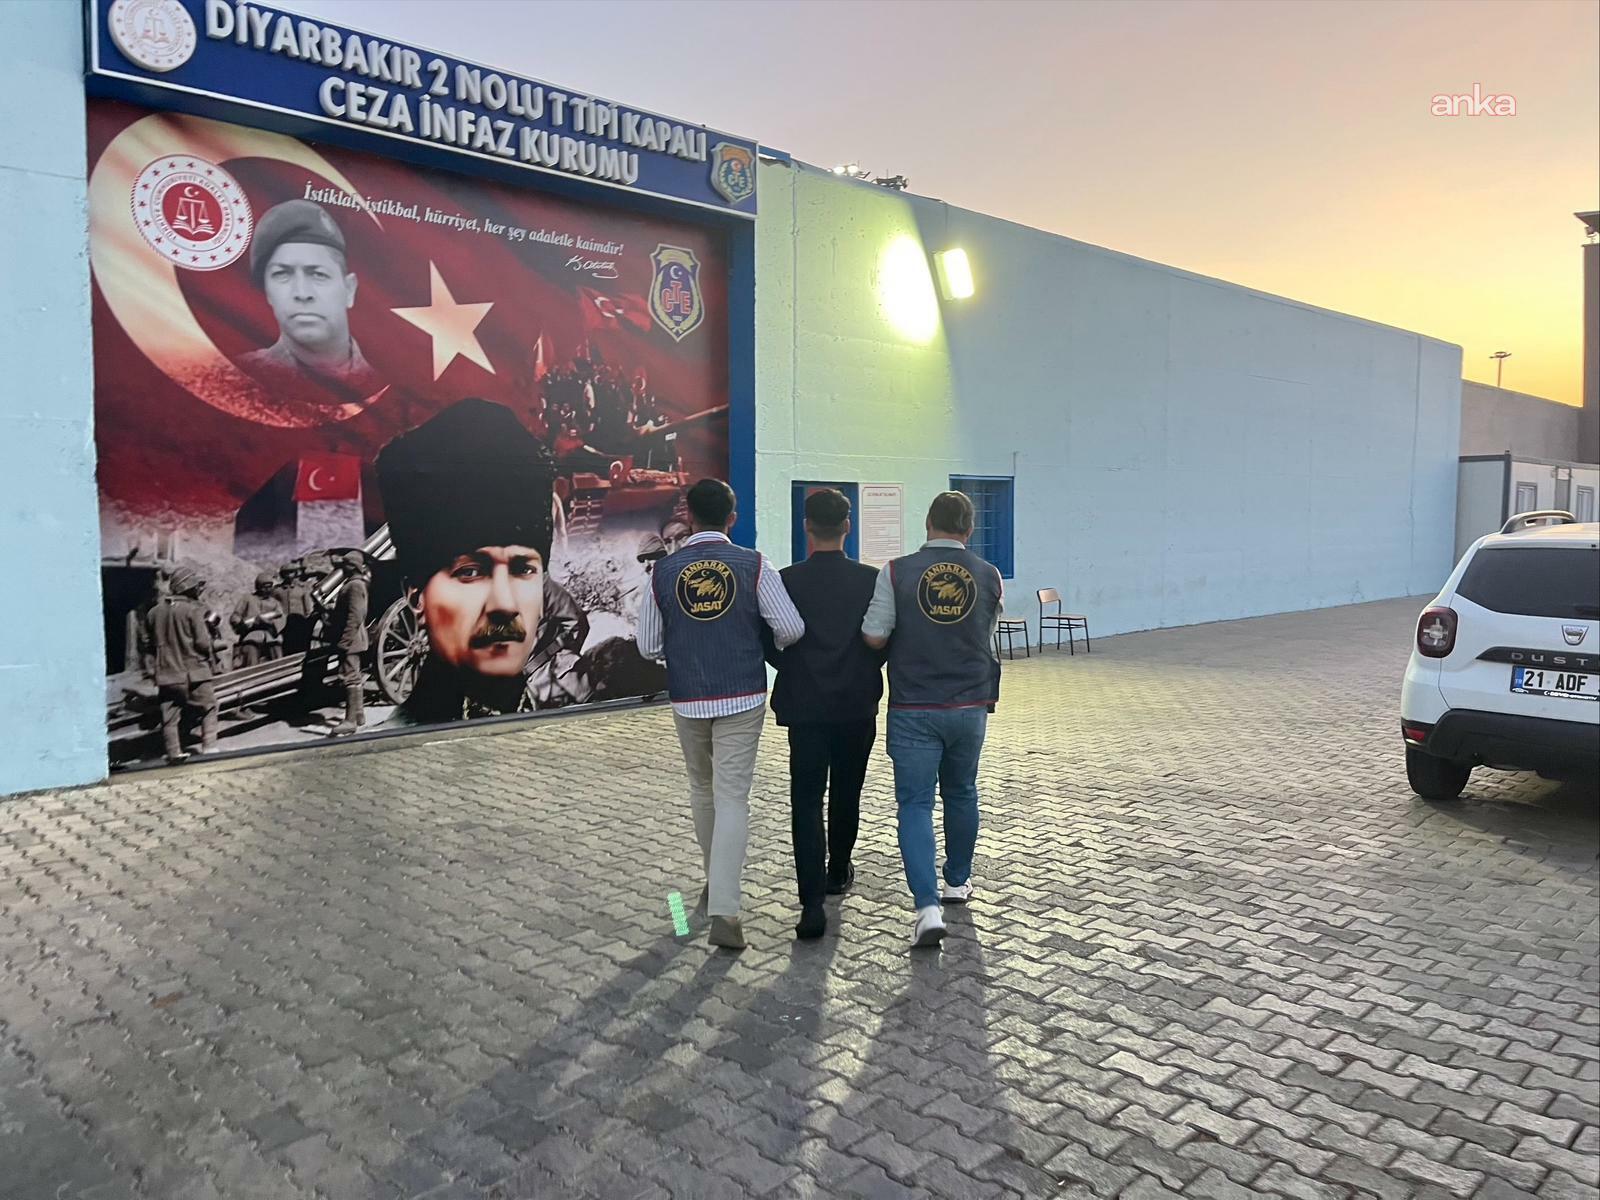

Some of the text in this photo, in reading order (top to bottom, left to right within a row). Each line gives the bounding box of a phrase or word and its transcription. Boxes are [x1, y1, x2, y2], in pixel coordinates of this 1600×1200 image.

[206, 0, 423, 88] DİYARBAKIR
[427, 58, 450, 97] 2
[455, 65, 544, 120] NOLU
[548, 91, 567, 127] T
[569, 96, 619, 140] TİPİ
[622, 111, 707, 162] KAPALI
[318, 76, 639, 185] CEZA İNFAZ KURUMU
[484, 218, 506, 235] her
[508, 226, 528, 242] şey
[529, 228, 574, 248] adaletle
[681, 561, 731, 582] JANDARMA
[924, 564, 973, 585] JANDARMA
[690, 600, 723, 614] JASAT
[929, 604, 964, 616] JASAT
[1524, 670, 1544, 688] 21
[1555, 672, 1588, 692] ADF
